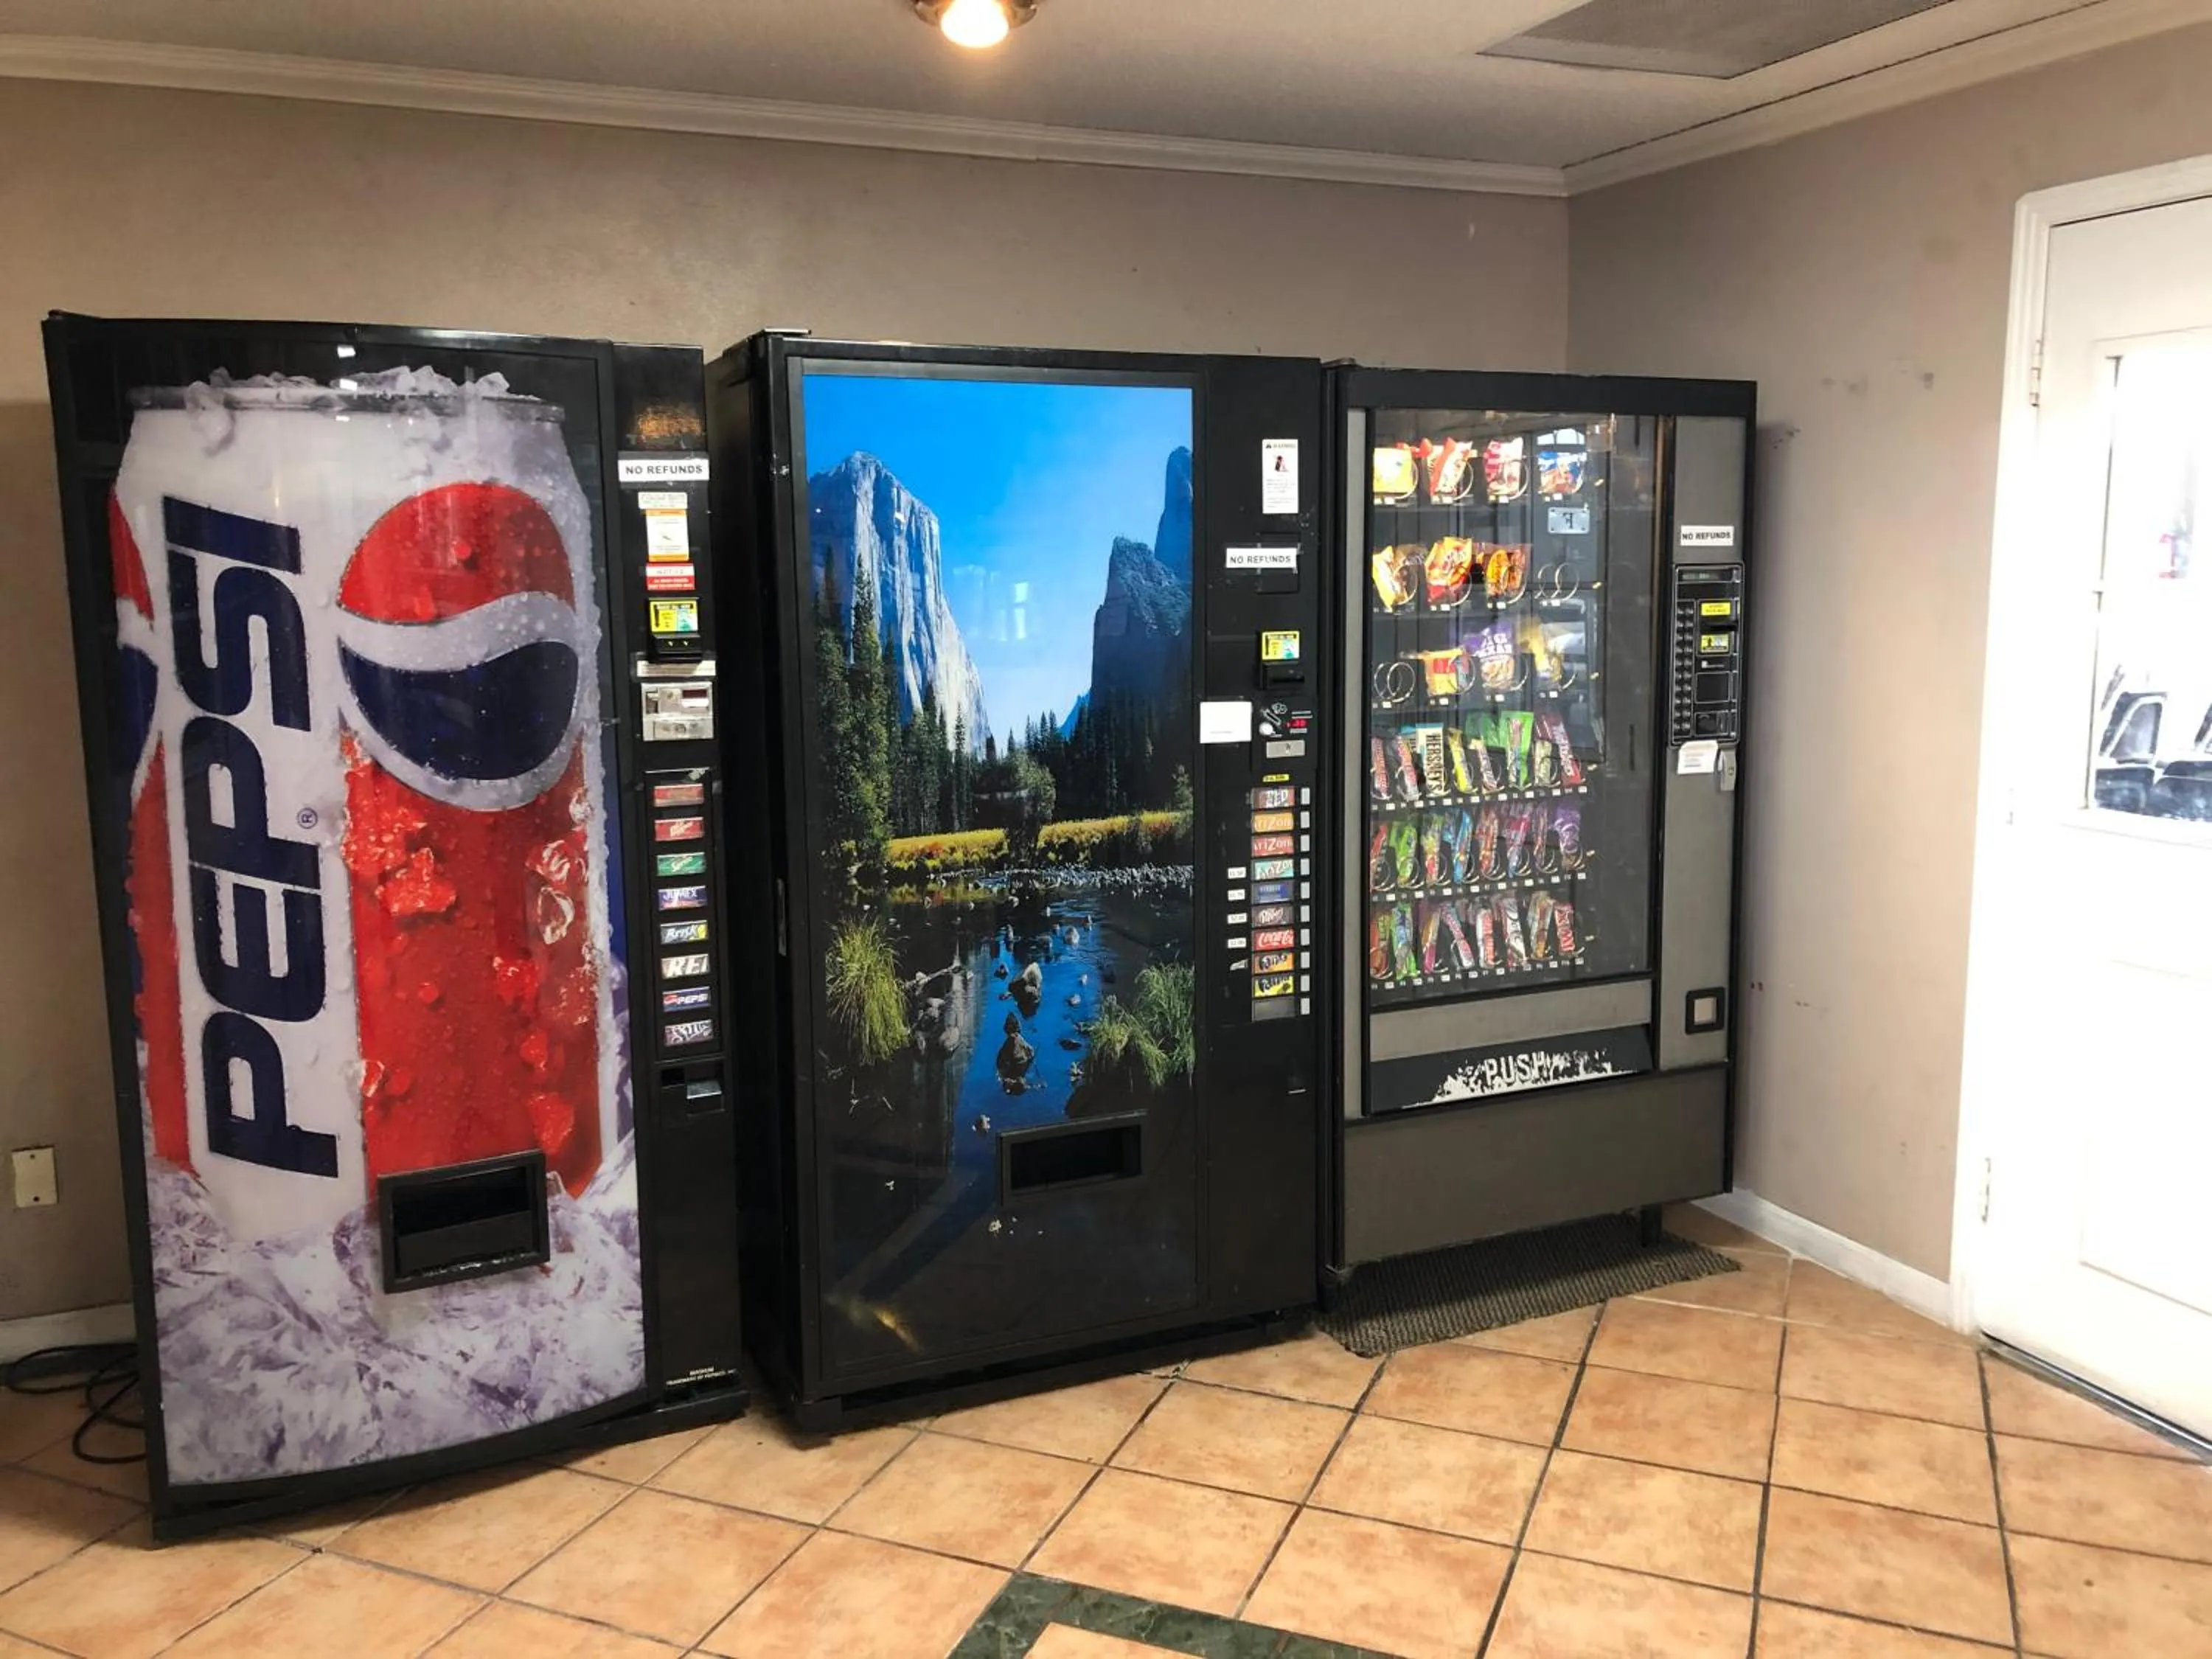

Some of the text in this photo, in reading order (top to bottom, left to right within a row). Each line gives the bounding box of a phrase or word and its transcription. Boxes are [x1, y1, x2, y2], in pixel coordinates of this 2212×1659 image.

[625, 462, 703, 475] NO REFUNDS
[1696, 532, 1731, 540] REFUNDS
[1230, 554, 1292, 564] NO REFUNDS
[162, 495, 338, 1178] PEPSI
[1484, 1051, 1548, 1085] PUSH
